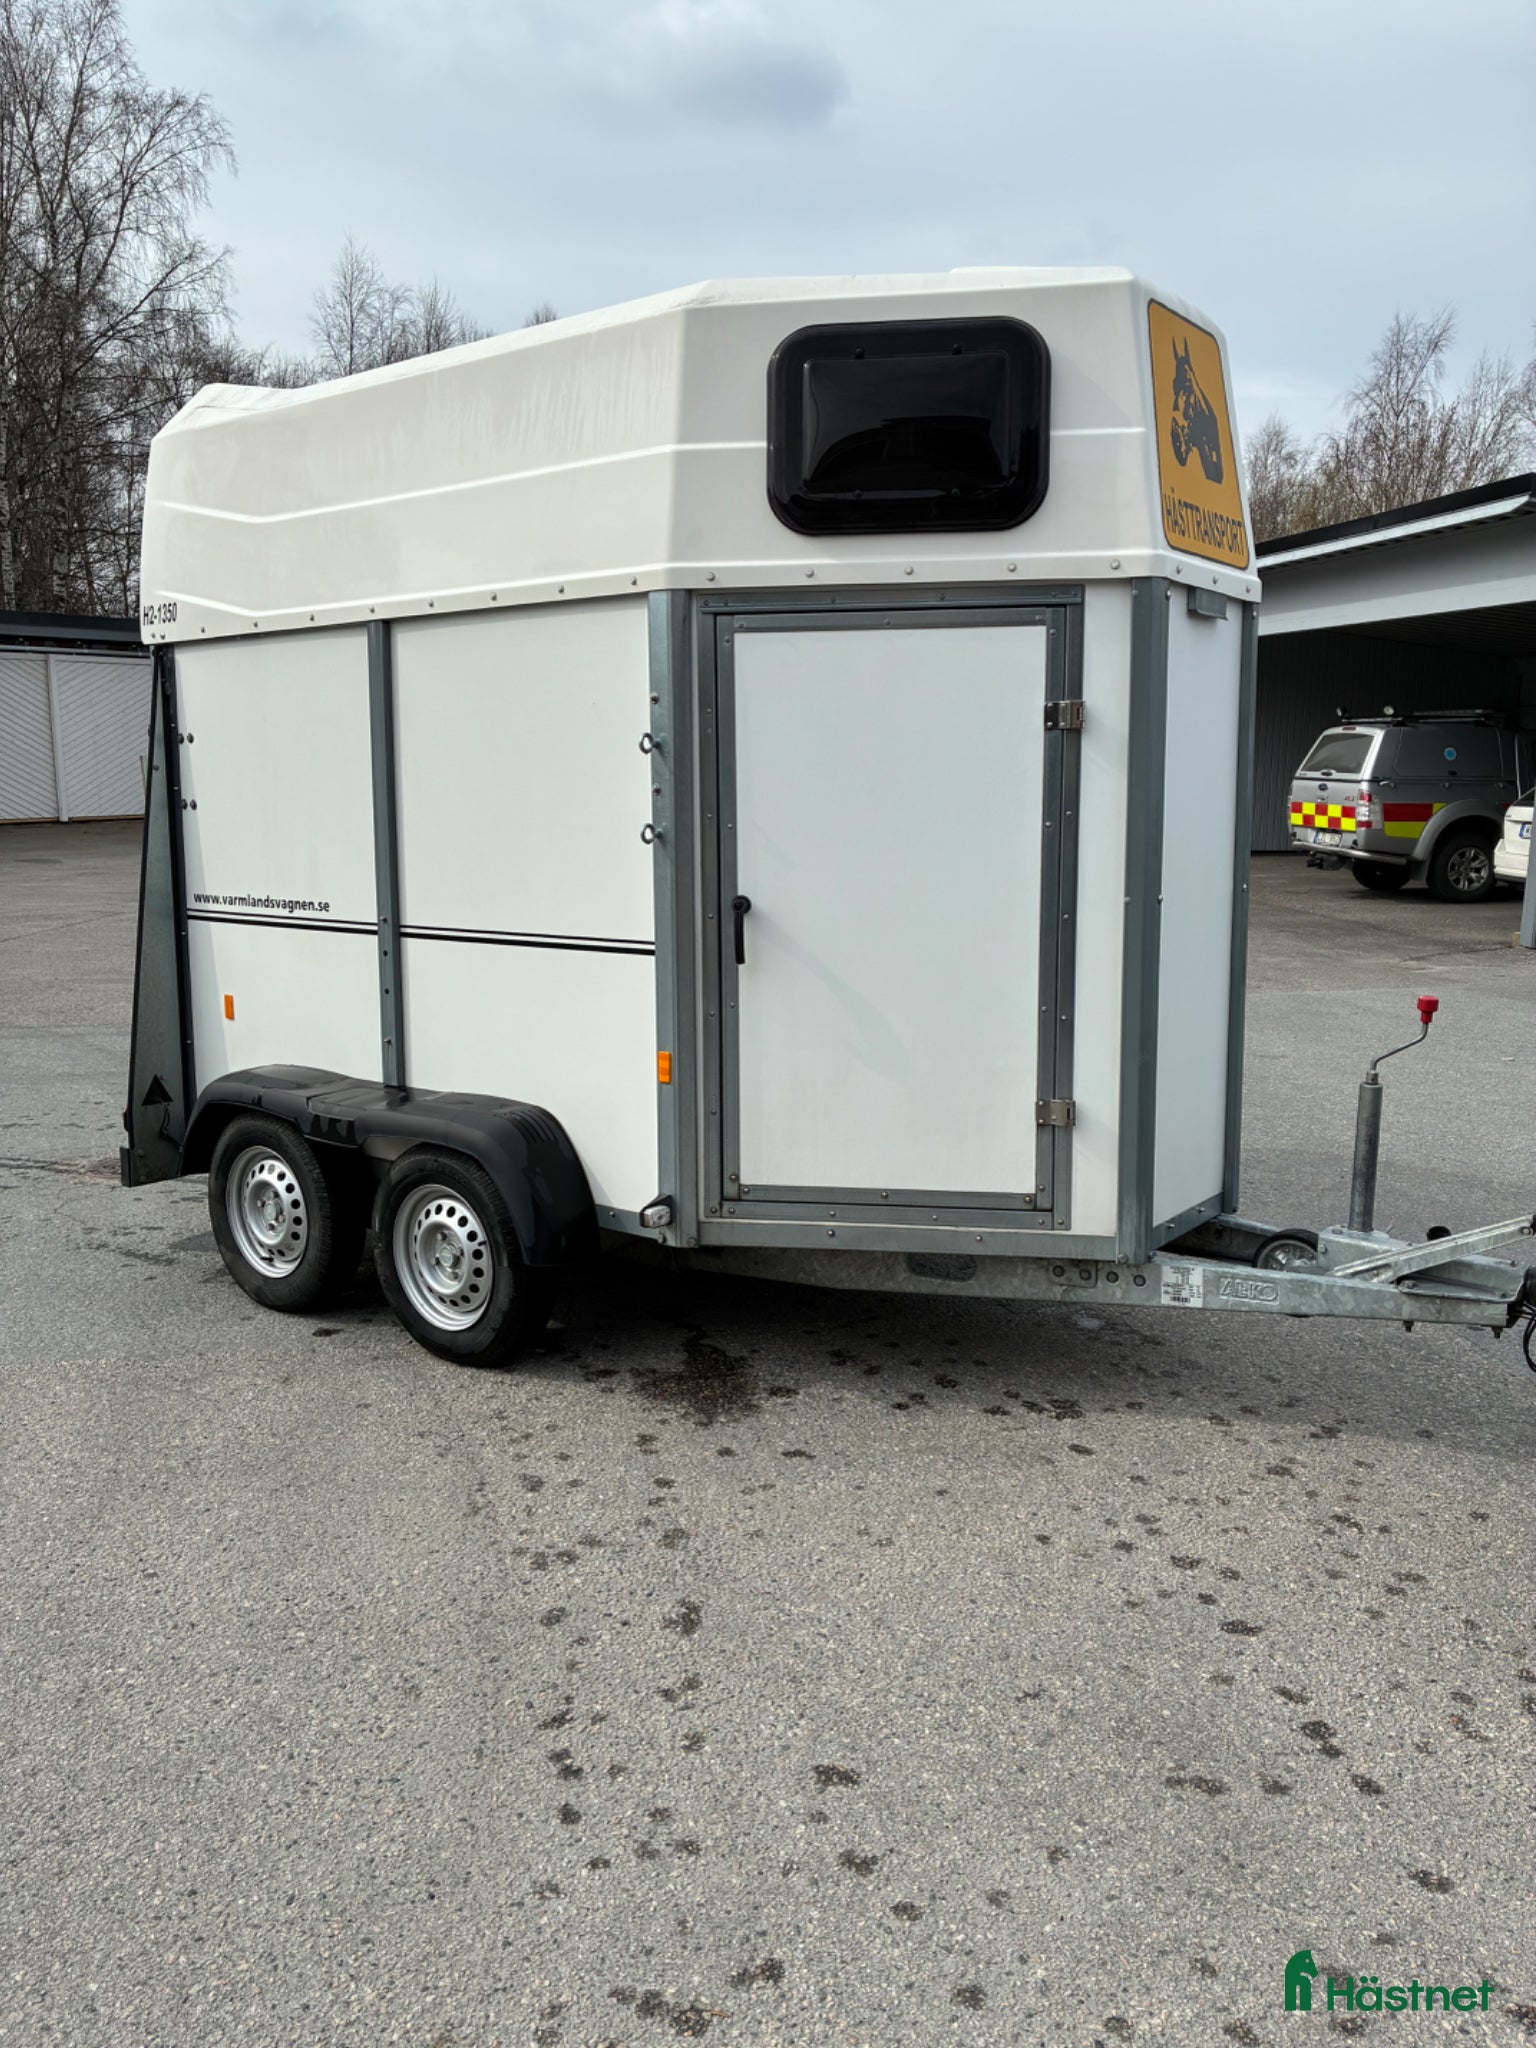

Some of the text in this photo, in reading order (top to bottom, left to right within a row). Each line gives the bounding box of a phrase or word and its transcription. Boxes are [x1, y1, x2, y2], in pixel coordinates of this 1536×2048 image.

[1164, 487, 1245, 556] HÄSTTRANSPORT
[142, 602, 178, 626] H2-1350
[193, 893, 331, 914] www.varmlandsvagnen.se
